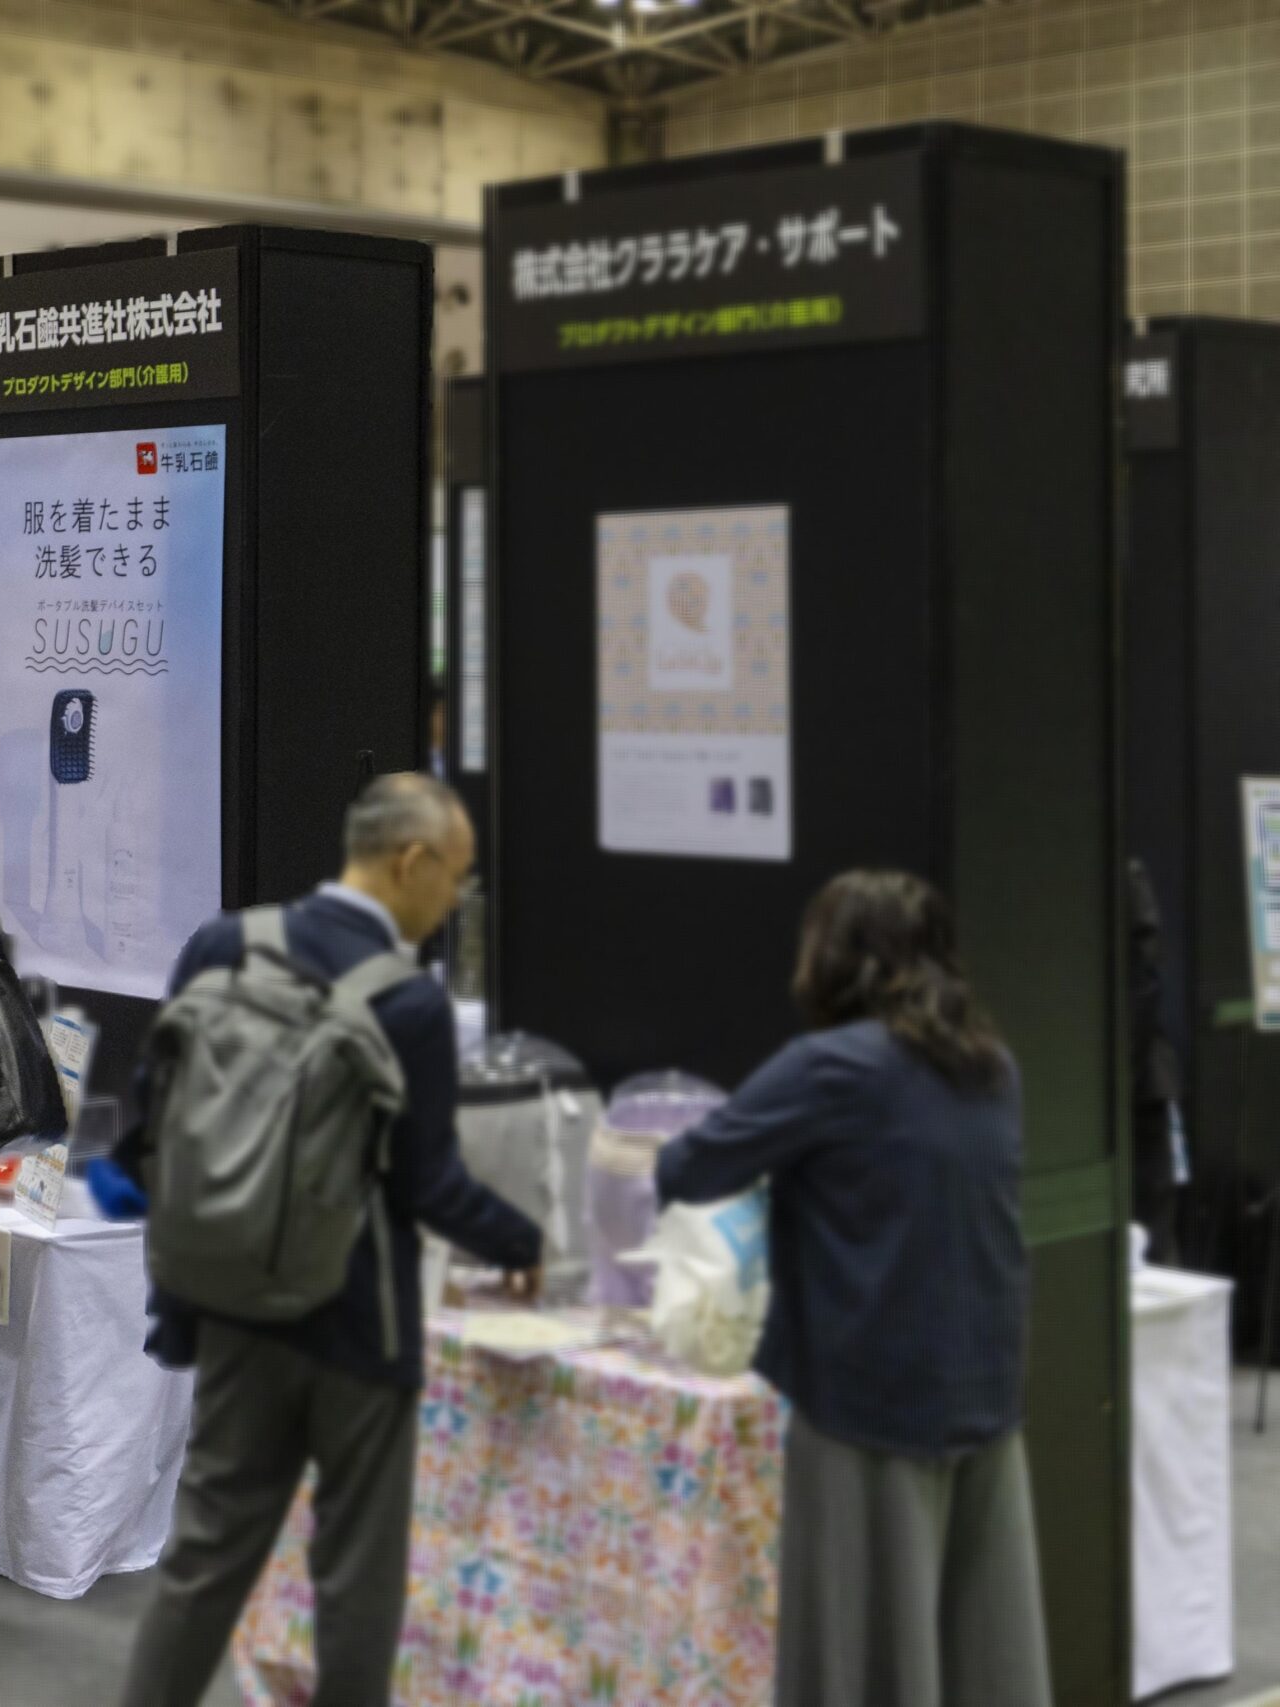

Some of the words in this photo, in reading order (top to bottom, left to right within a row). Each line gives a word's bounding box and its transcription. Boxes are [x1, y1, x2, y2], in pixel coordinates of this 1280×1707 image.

[23, 495, 171, 535] 服を着たまま
[34, 543, 158, 579] 洗髪できる
[37, 598, 164, 613] ポータブル洗髪デバイスセット
[32, 617, 165, 657] SUSUGU
